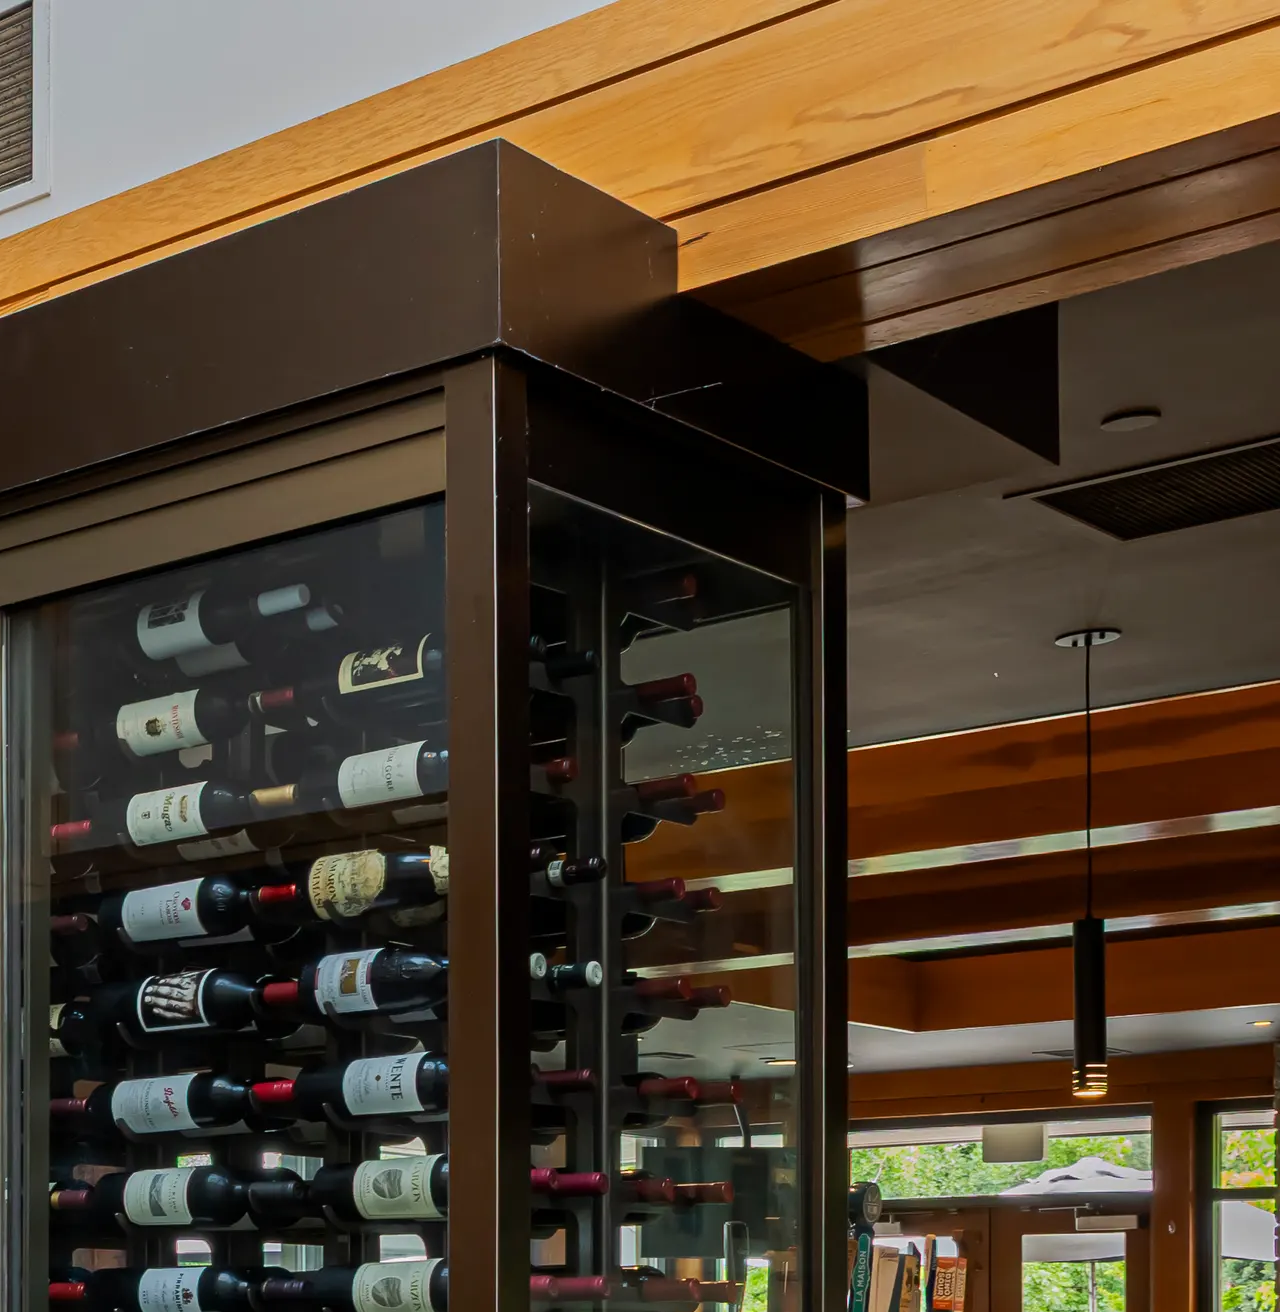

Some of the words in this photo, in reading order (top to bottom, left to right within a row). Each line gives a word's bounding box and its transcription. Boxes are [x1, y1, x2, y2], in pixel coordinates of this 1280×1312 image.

[390, 1057, 407, 1101] WENTE
[857, 1250, 868, 1287] MAISON
[855, 1289, 864, 1302] LA
[937, 1271, 945, 1296] SOUR
[944, 1272, 952, 1296] DINO
